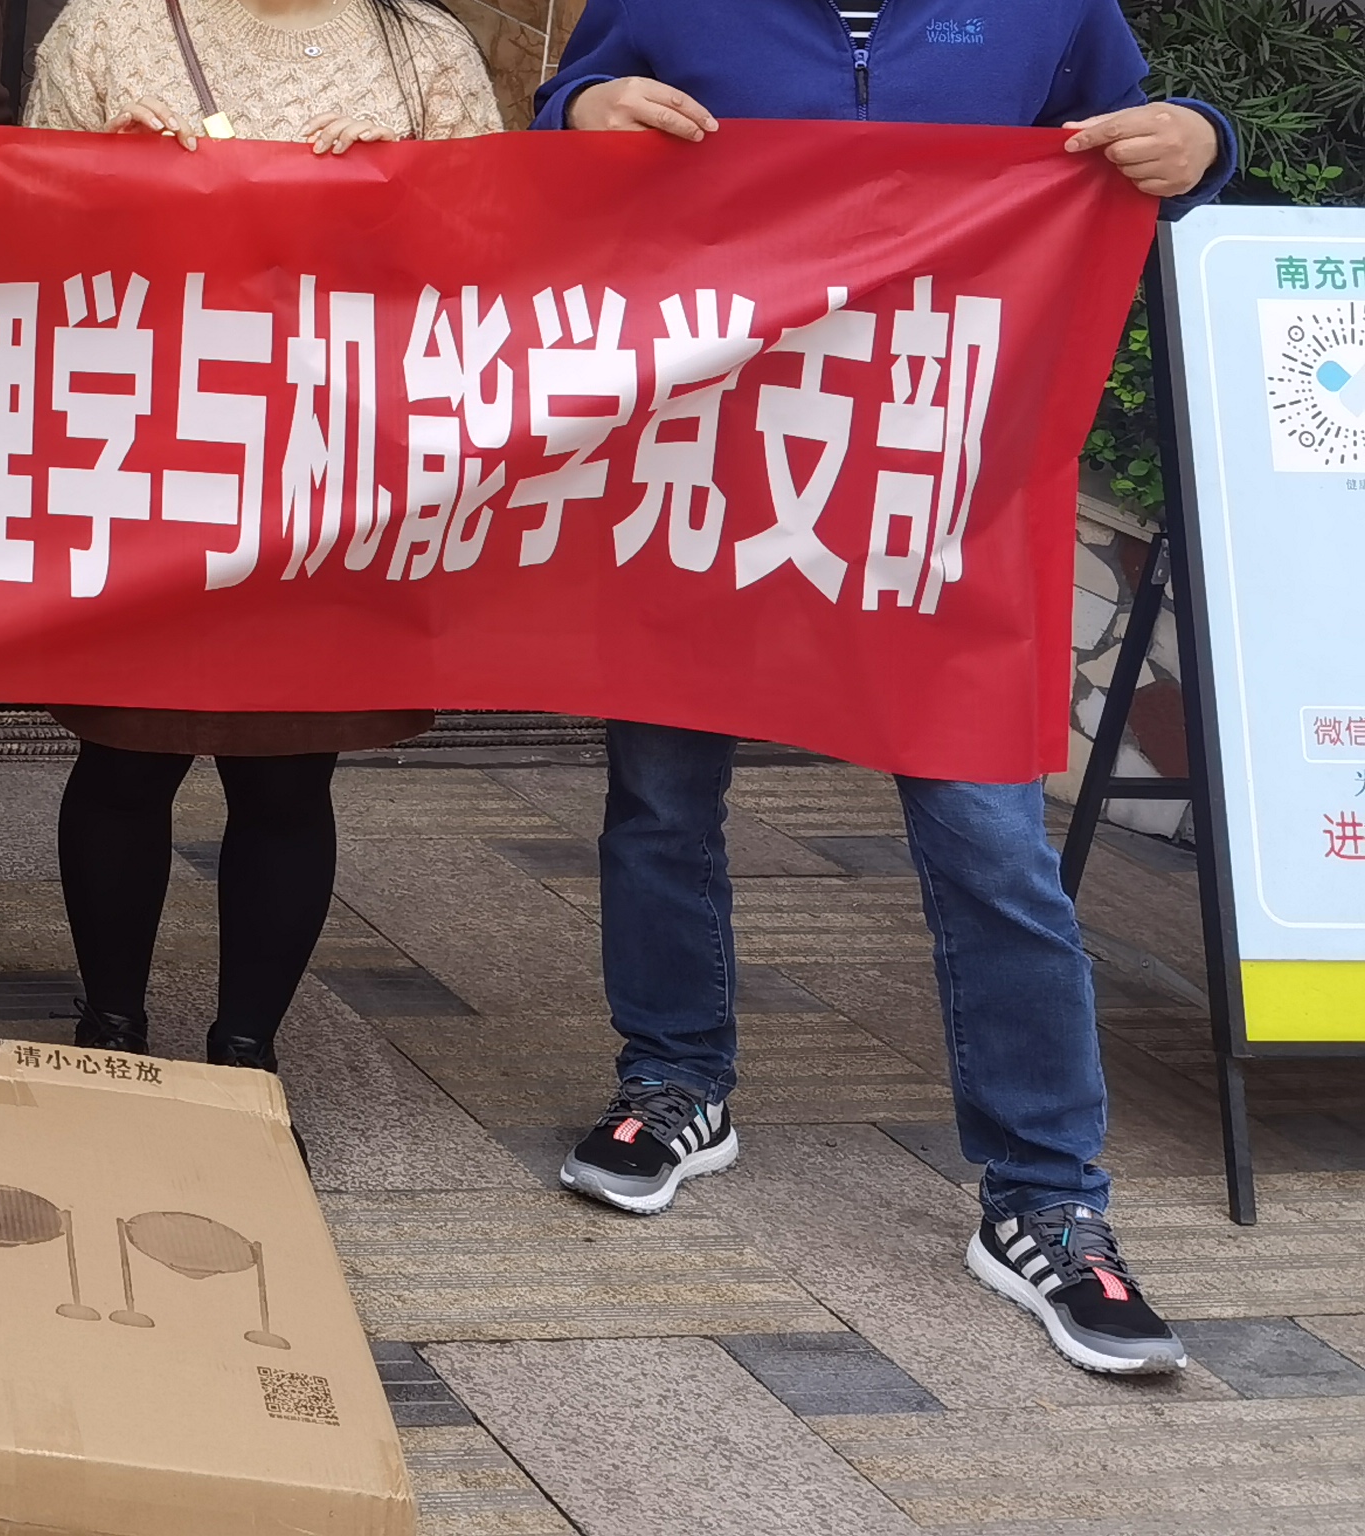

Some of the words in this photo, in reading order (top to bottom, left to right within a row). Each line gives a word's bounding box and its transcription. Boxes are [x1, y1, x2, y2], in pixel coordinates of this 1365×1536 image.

[926, 18, 959, 33] Jack
[926, 29, 985, 44] Wolfskin
[1314, 717, 1365, 746] 微信
[14, 1045, 164, 1086] 请小心轻放
